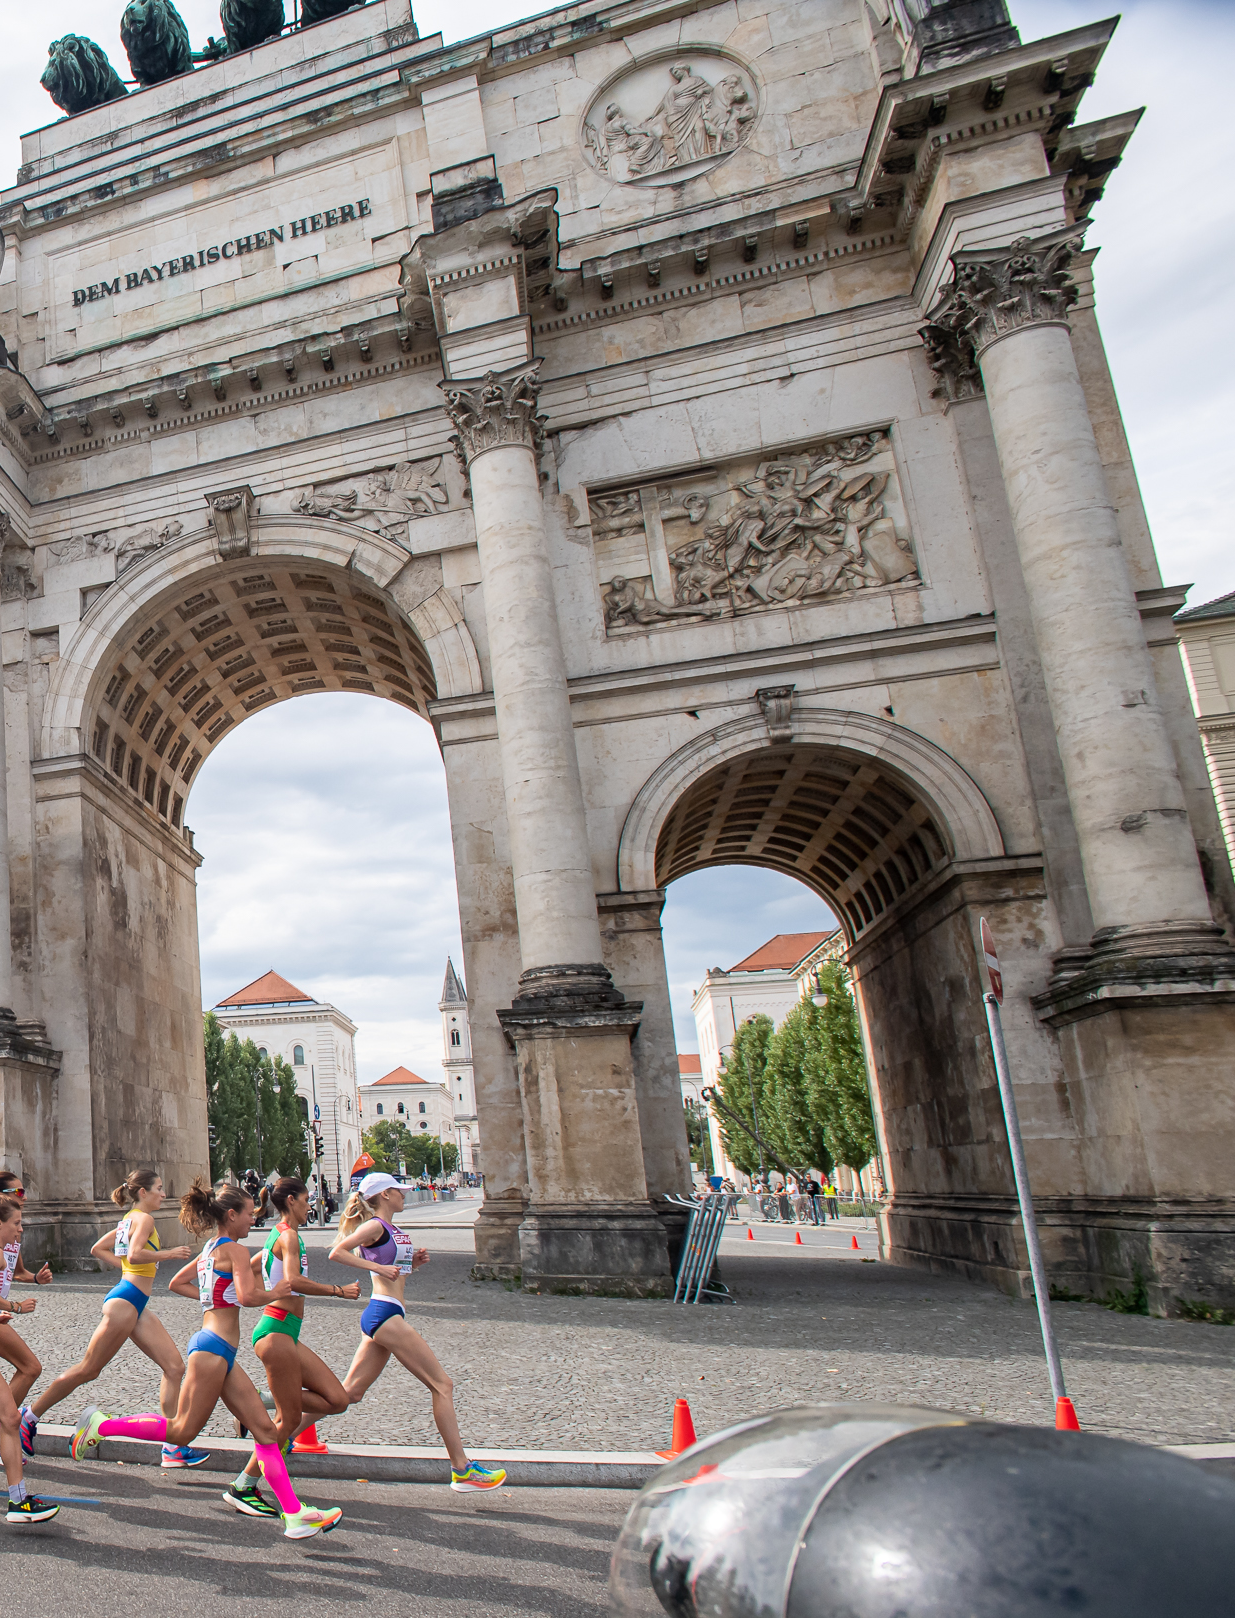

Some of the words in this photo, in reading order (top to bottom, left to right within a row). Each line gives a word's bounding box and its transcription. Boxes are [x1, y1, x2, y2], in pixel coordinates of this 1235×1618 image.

[72, 276, 121, 307] DEM
[124, 225, 284, 290] BAYERISCHEN
[289, 198, 372, 239] HEERE
